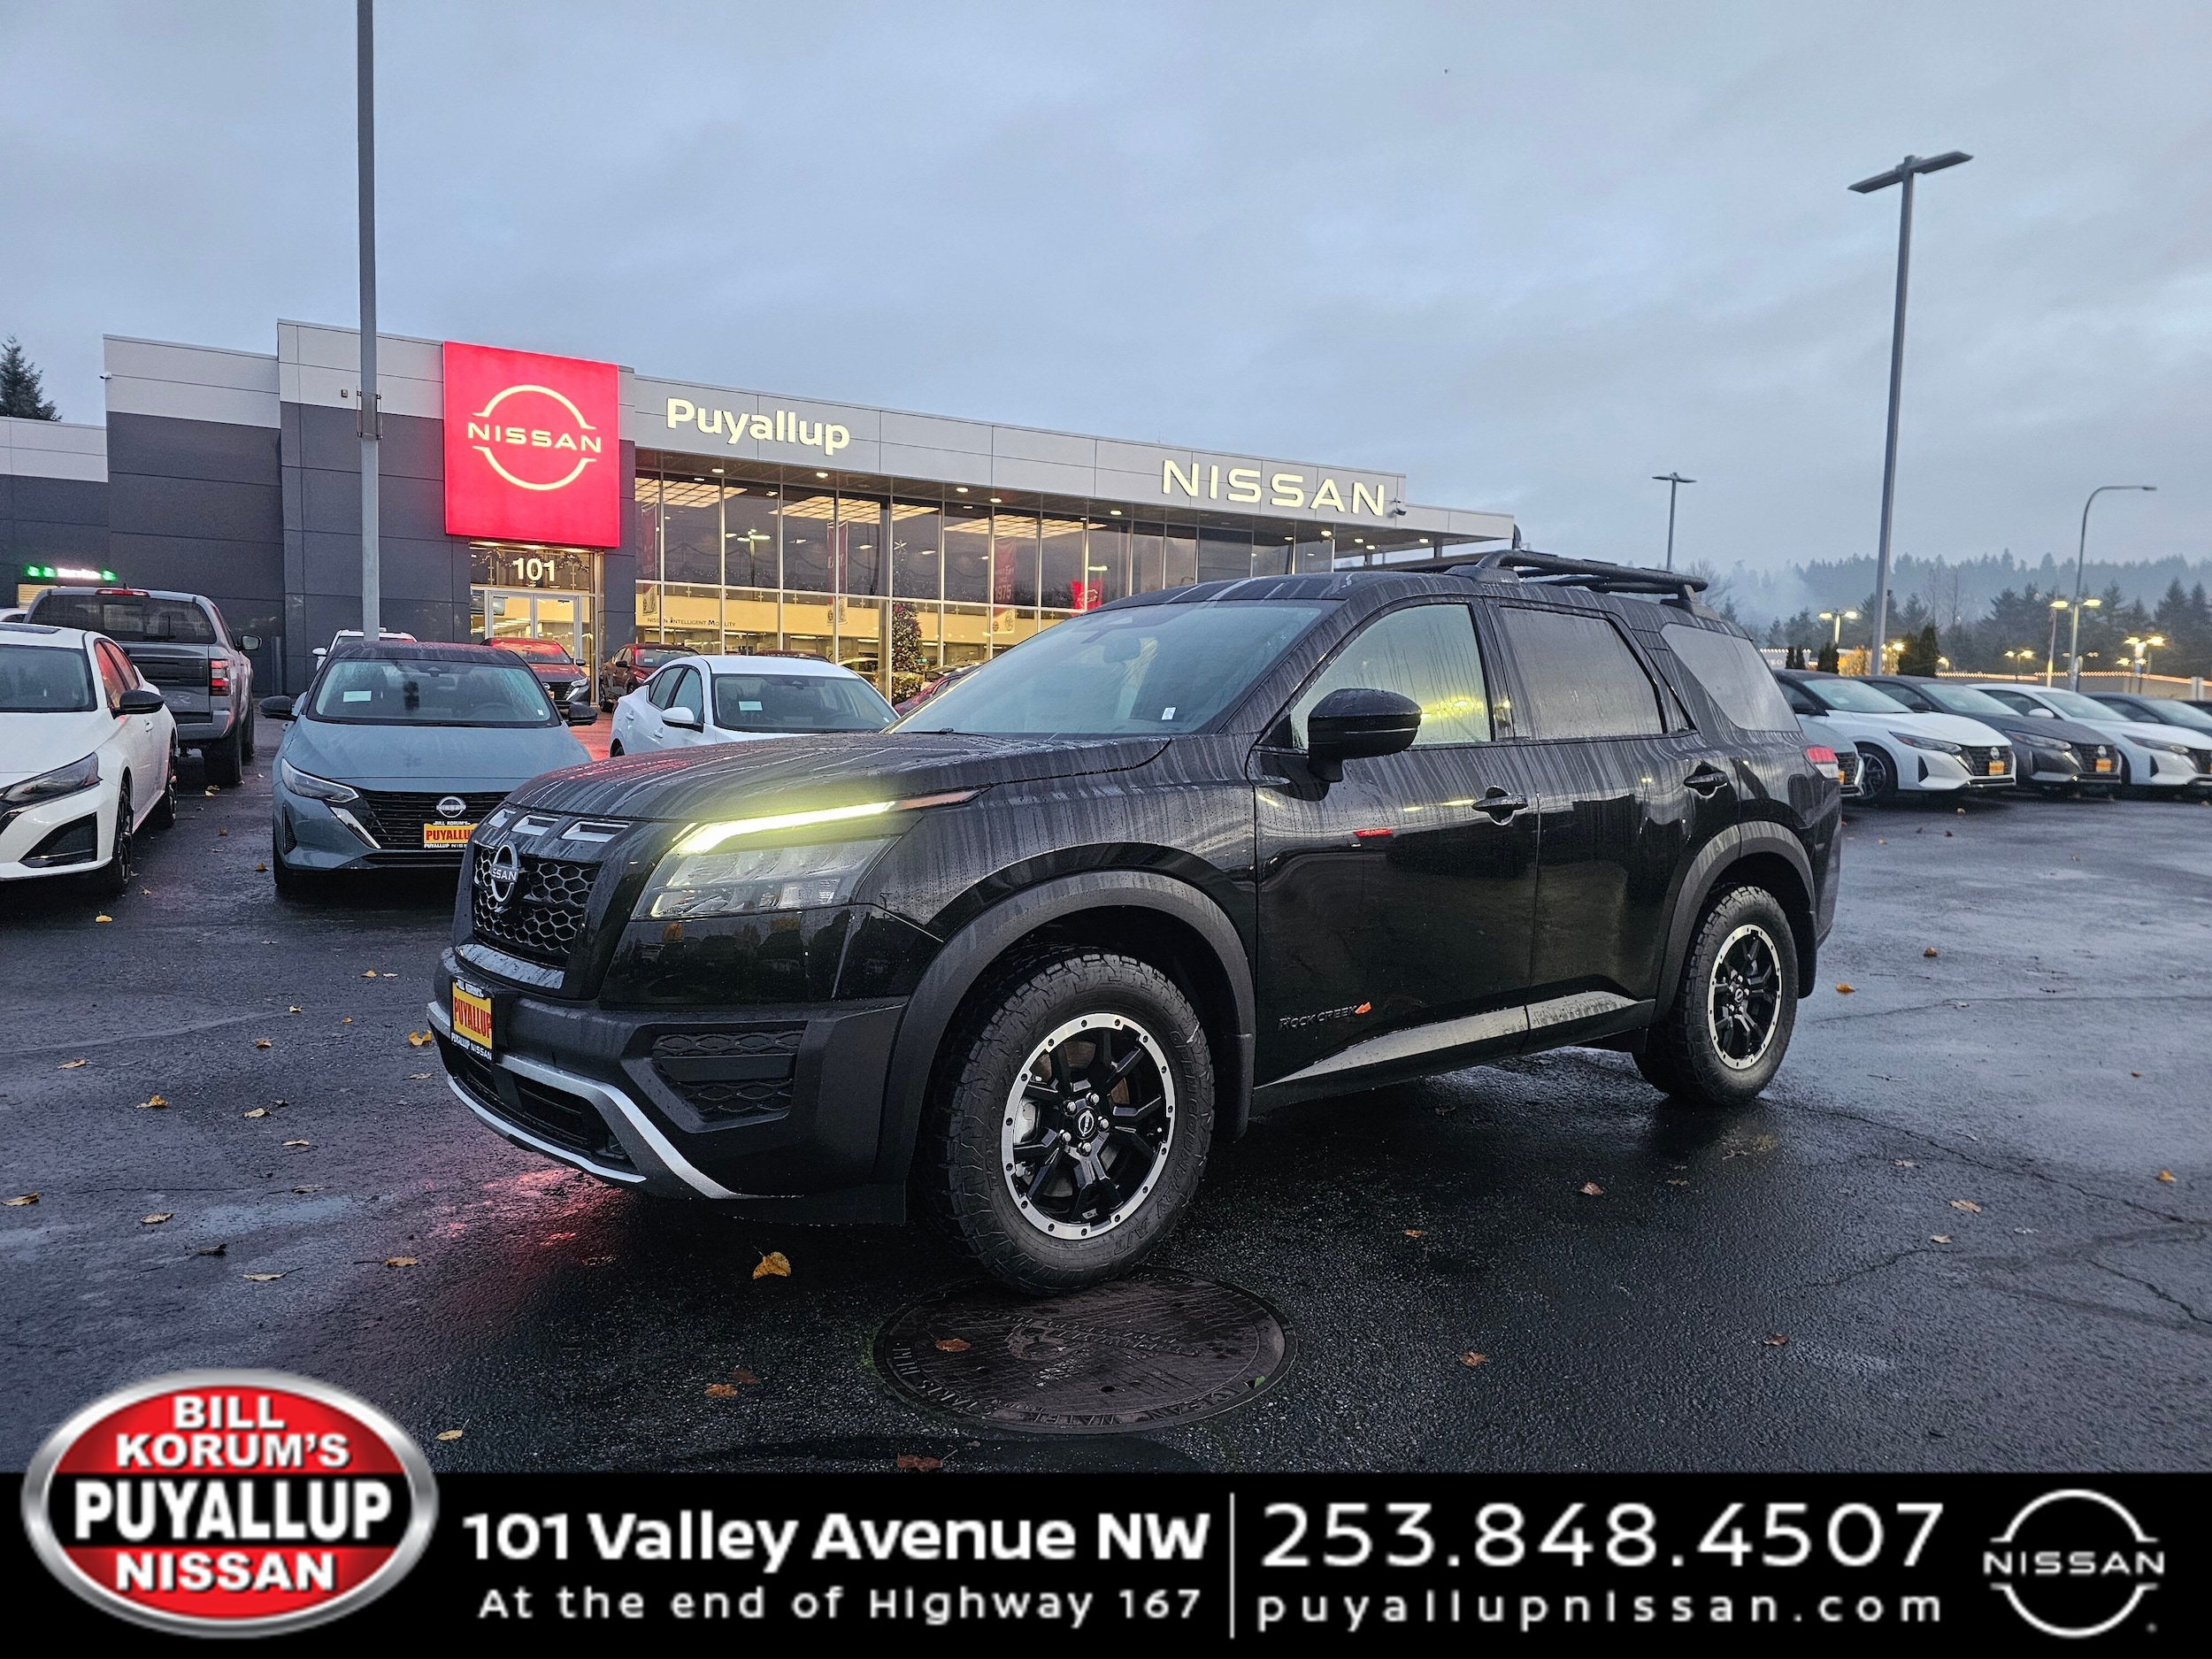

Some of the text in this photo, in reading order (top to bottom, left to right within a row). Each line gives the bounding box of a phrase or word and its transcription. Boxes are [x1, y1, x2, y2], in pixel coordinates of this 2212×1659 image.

[467, 422, 601, 453] NISSAN
[666, 397, 849, 455] Puyallup
[1162, 459, 1385, 517] NISSAN
[513, 557, 555, 581] 101
[426, 829, 473, 840] PUYALLU
[491, 868, 517, 881] SSAN
[454, 996, 492, 1039] PUYALLUP
[1278, 1005, 1357, 1032] ROCK CREEK
